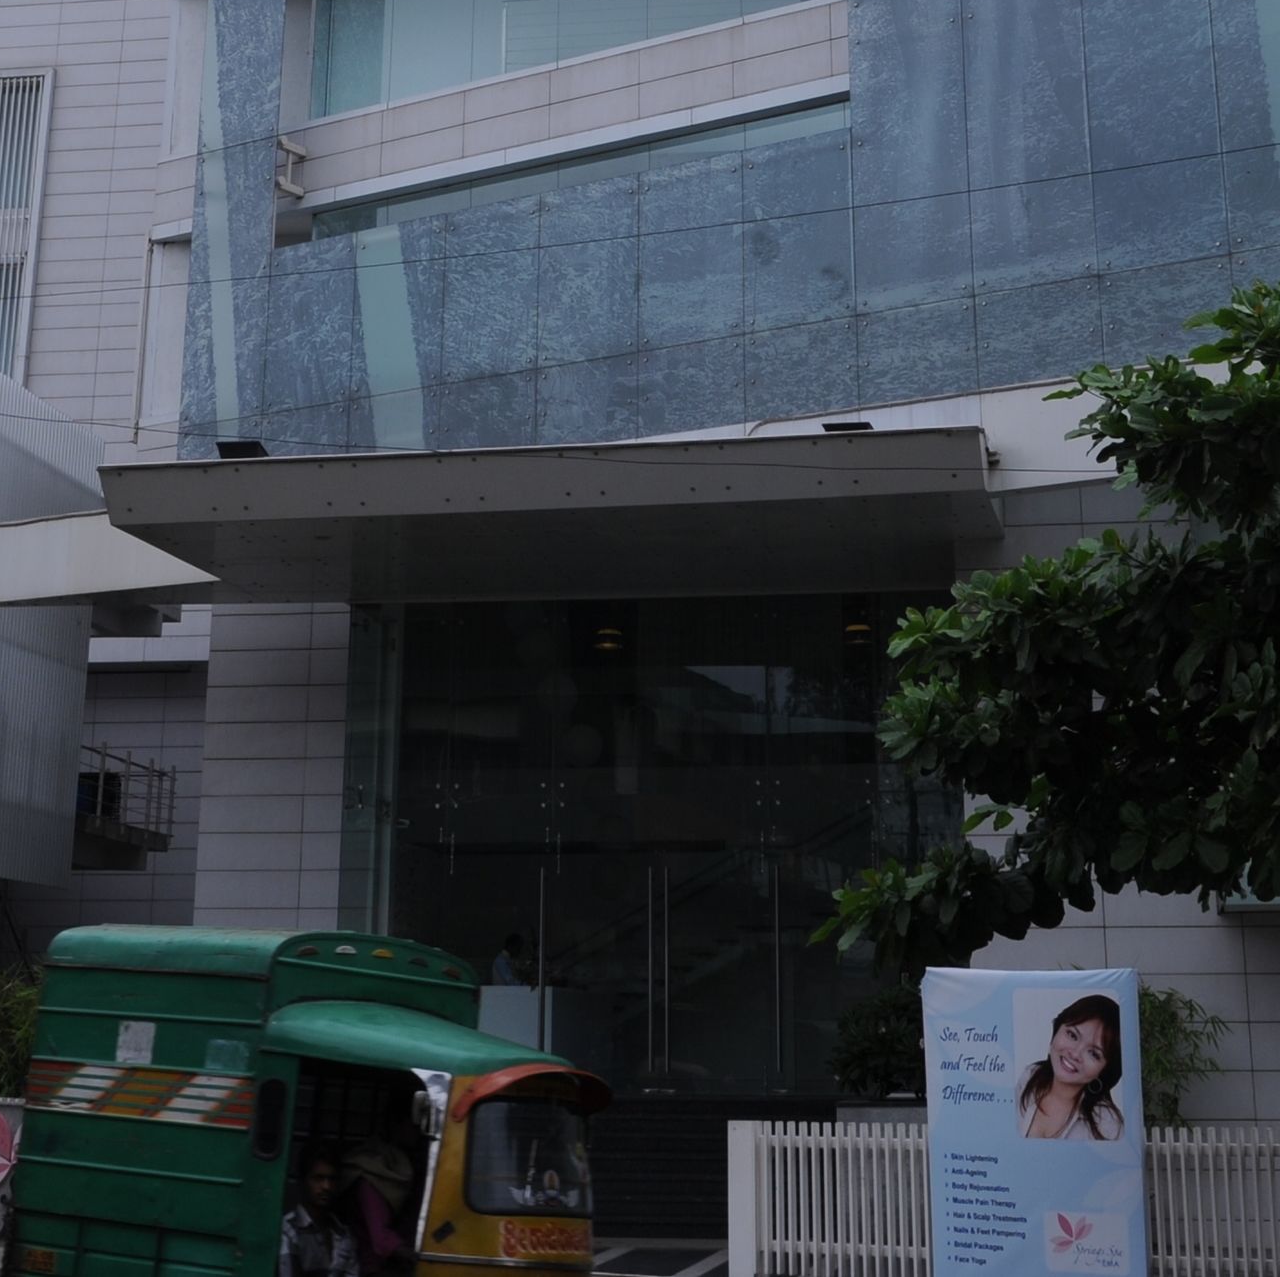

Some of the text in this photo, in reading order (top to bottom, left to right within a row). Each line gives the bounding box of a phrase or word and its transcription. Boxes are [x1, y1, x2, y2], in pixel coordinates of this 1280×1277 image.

[939, 1025, 998, 1043] See, Touch
[940, 1053, 1006, 1073] and Feel the
[951, 1153, 998, 1164] Skin Lightening
[952, 1182, 968, 1191] Body
[952, 1196, 1016, 1210] Muscle Pain Therapy
[953, 1211, 966, 1219] Hair
[973, 1212, 991, 1222] Scalp
[953, 1226, 969, 1234] Nails
[992, 1228, 1026, 1240] Pampering
[974, 1241, 1004, 1252] Packages
[954, 1255, 987, 1266] Face Yoga
